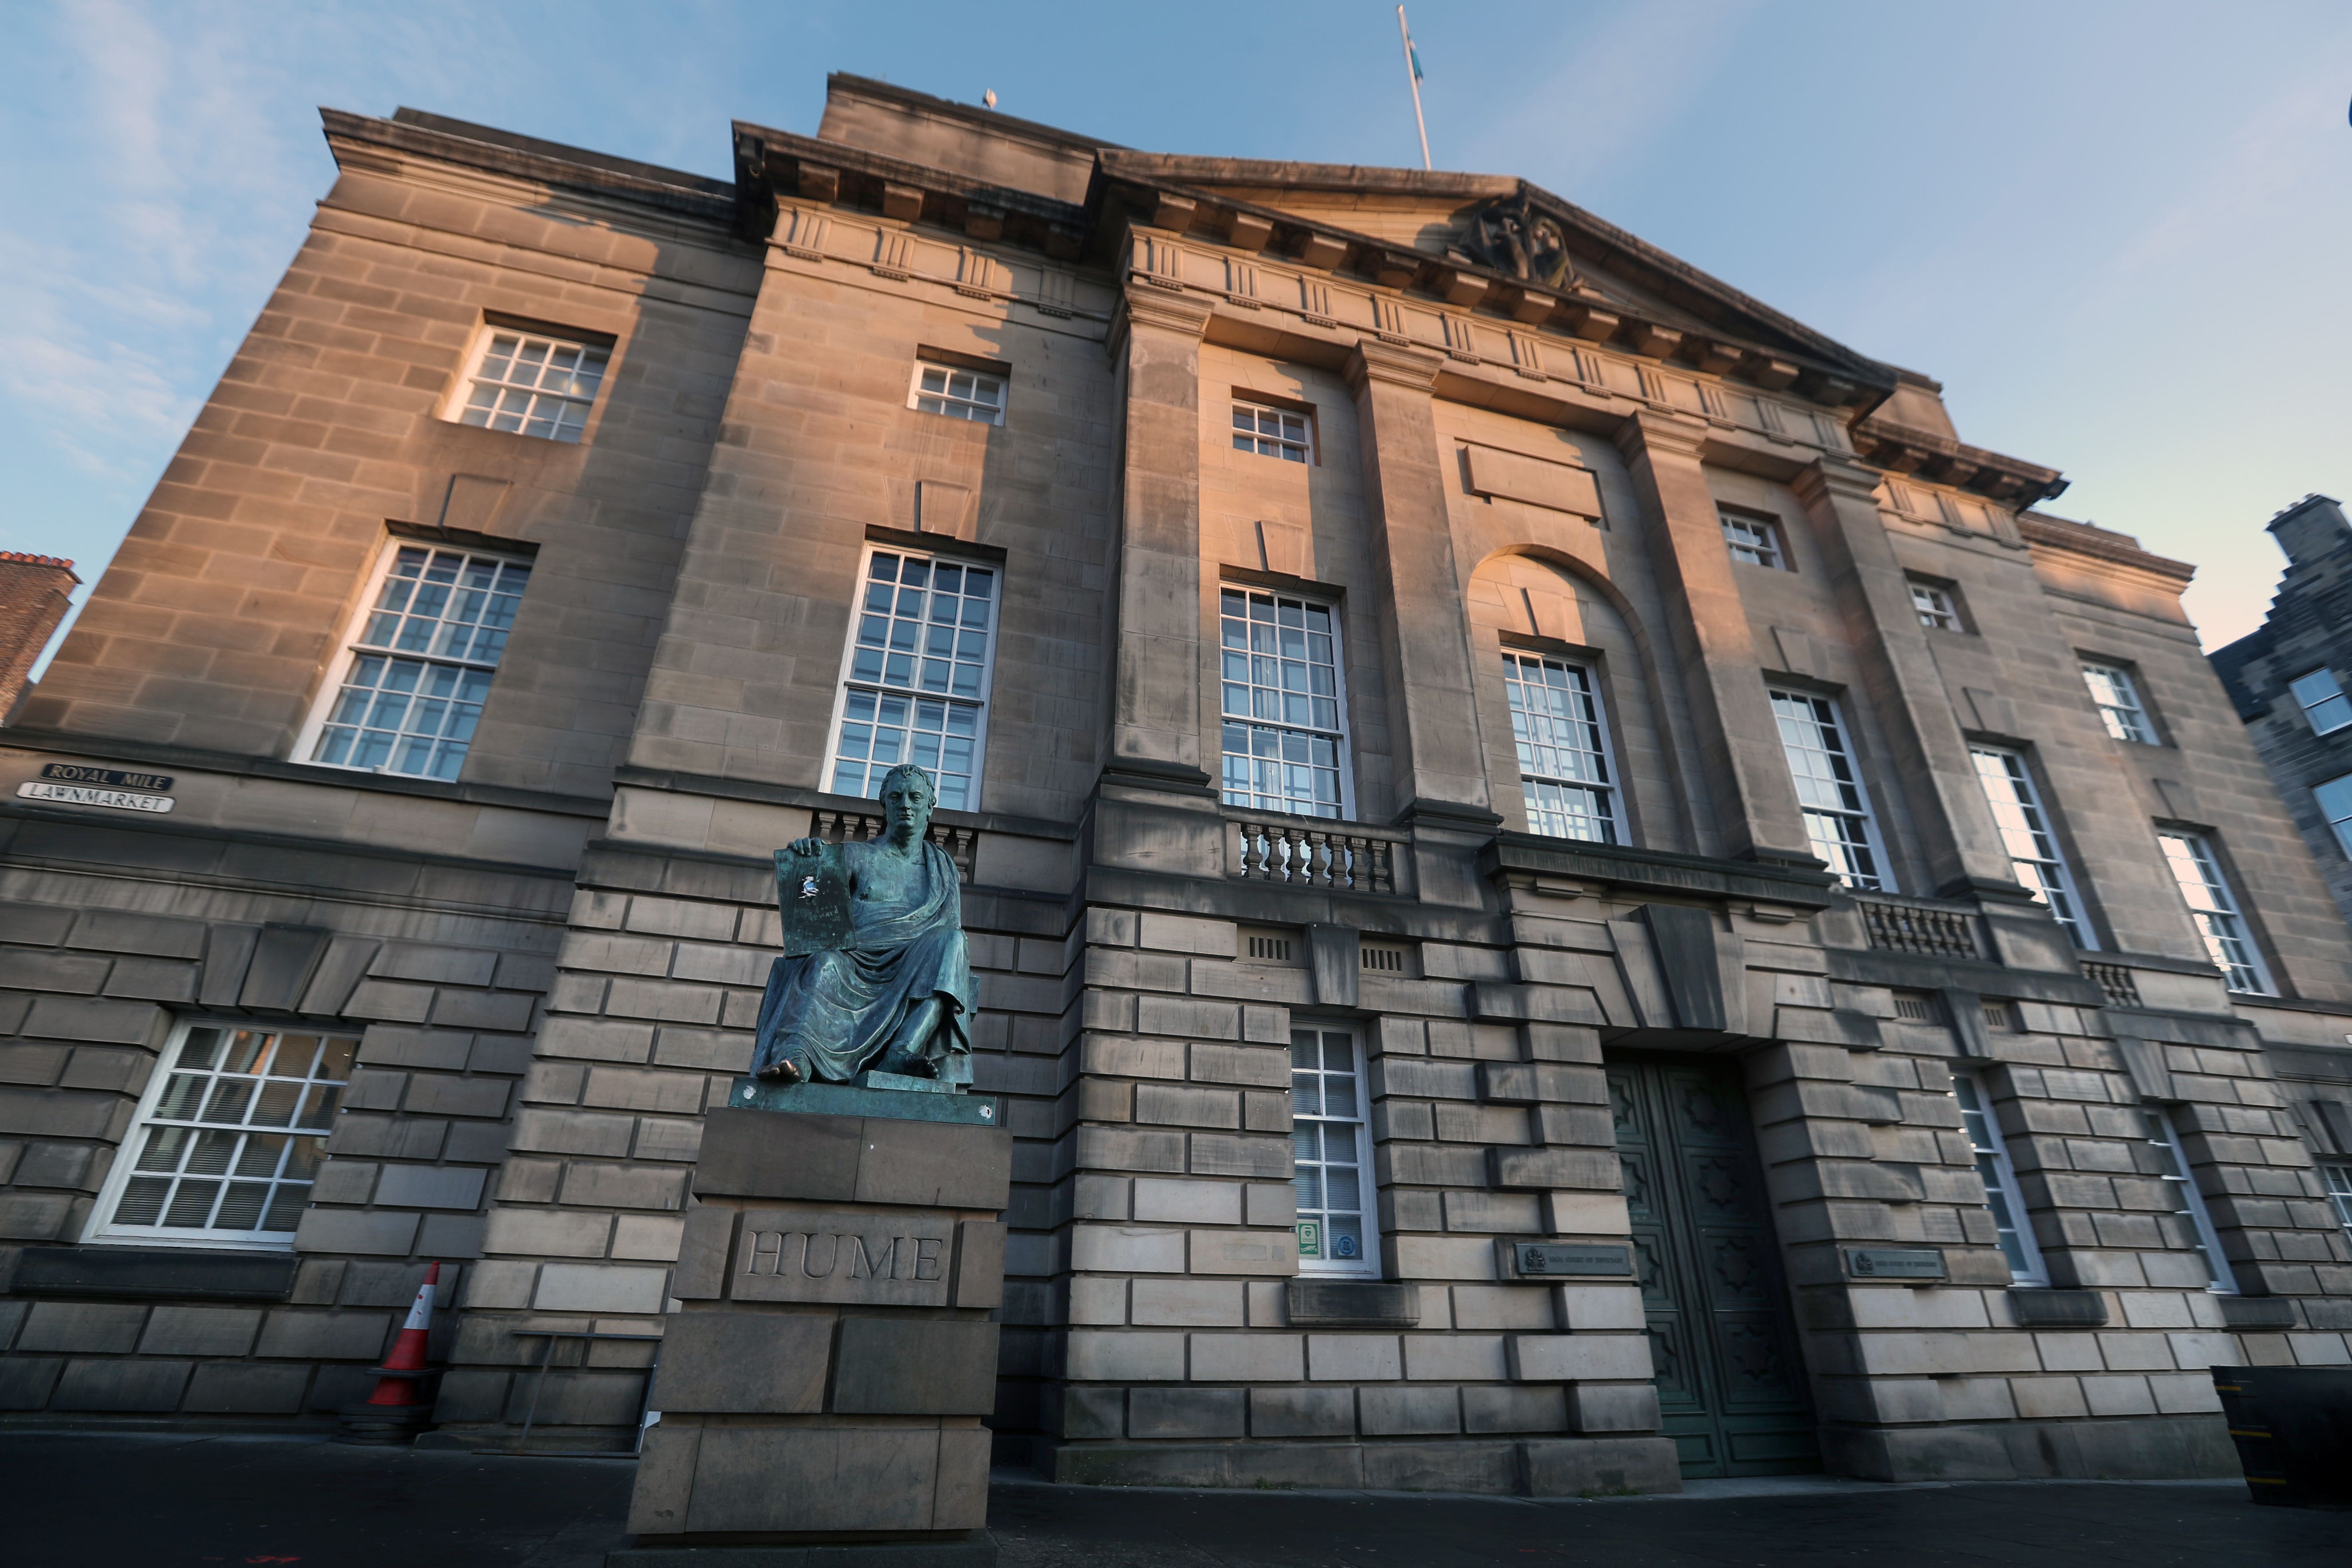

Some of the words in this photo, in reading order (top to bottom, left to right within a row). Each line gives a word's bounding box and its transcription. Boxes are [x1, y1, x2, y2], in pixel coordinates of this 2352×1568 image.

[49, 765, 110, 783] ROYAL
[120, 773, 167, 789] MILE
[29, 784, 164, 810] LAWNMARKET
[741, 1230, 943, 1282] HUME
